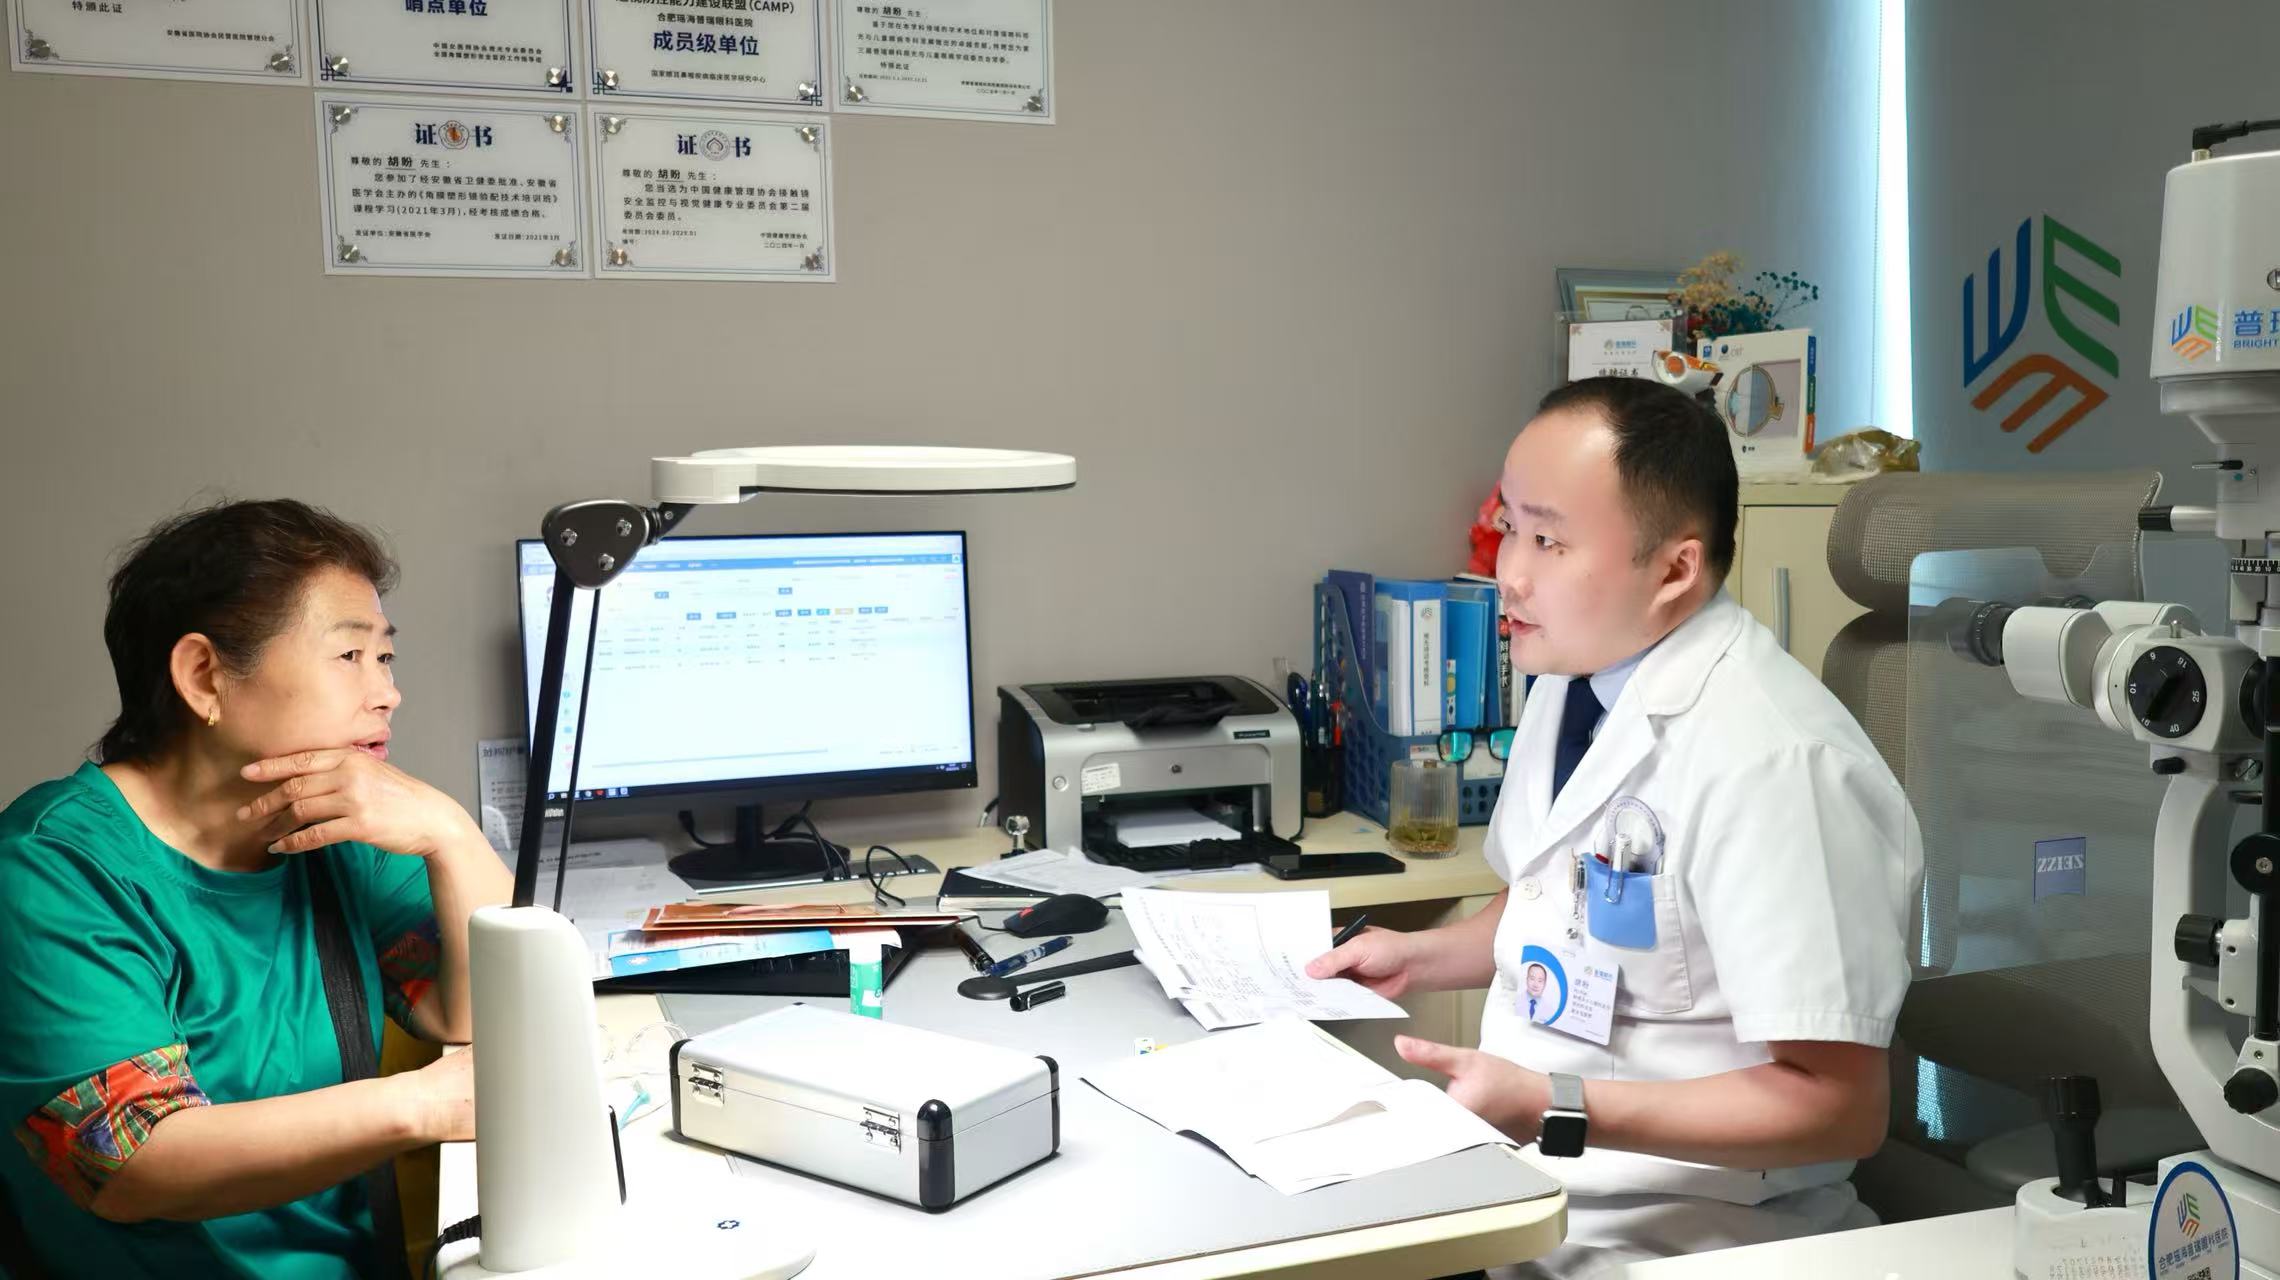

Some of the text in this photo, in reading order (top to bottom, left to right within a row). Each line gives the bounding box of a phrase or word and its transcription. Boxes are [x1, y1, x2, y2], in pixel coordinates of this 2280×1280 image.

[405, 0, 488, 17] 哨点单位
[657, 12, 754, 28] 合肥瑶海普瑞眼科医院
[653, 30, 760, 56] 成员级单位
[351, 156, 382, 167] 尊敬的
[622, 169, 653, 179] 尊敬的
[2129, 682, 2137, 694] 10
[2192, 690, 2200, 703] 25
[2169, 723, 2180, 733] 40
